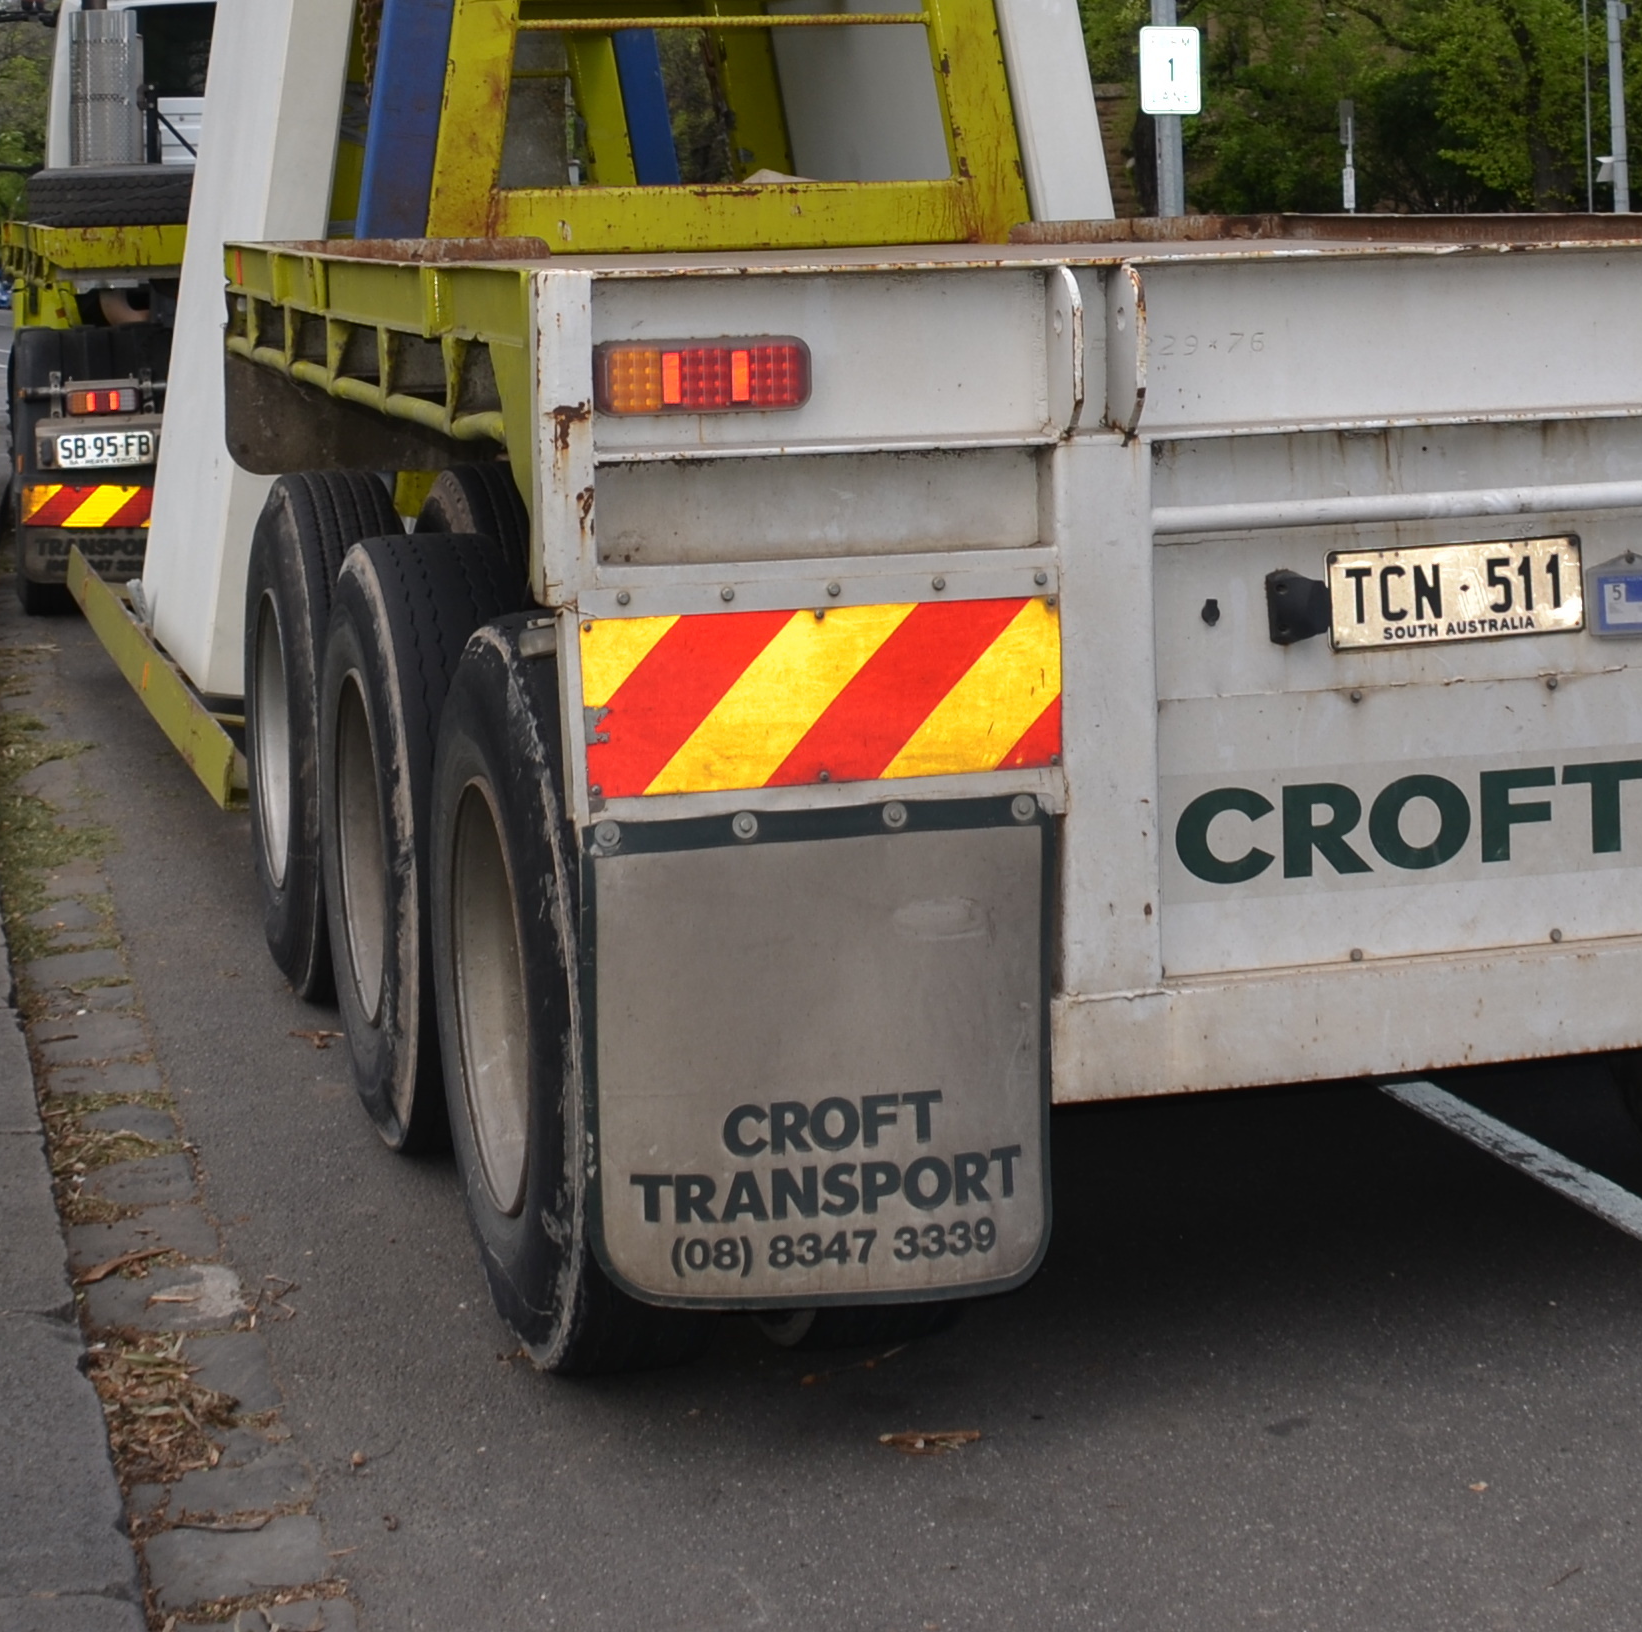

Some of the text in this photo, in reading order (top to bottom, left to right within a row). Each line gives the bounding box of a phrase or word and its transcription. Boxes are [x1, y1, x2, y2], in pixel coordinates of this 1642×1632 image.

[1168, 57, 1174, 82] 1
[35, 538, 146, 556] TRANSPO
[1612, 584, 1622, 601] 5
[1383, 616, 1535, 641] SOUTH AUSTRALIA
[721, 1090, 943, 1158] CROFT
[629, 1144, 1022, 1225] TRANSPORT
[670, 1217, 997, 1278] (08) 8347 3339
